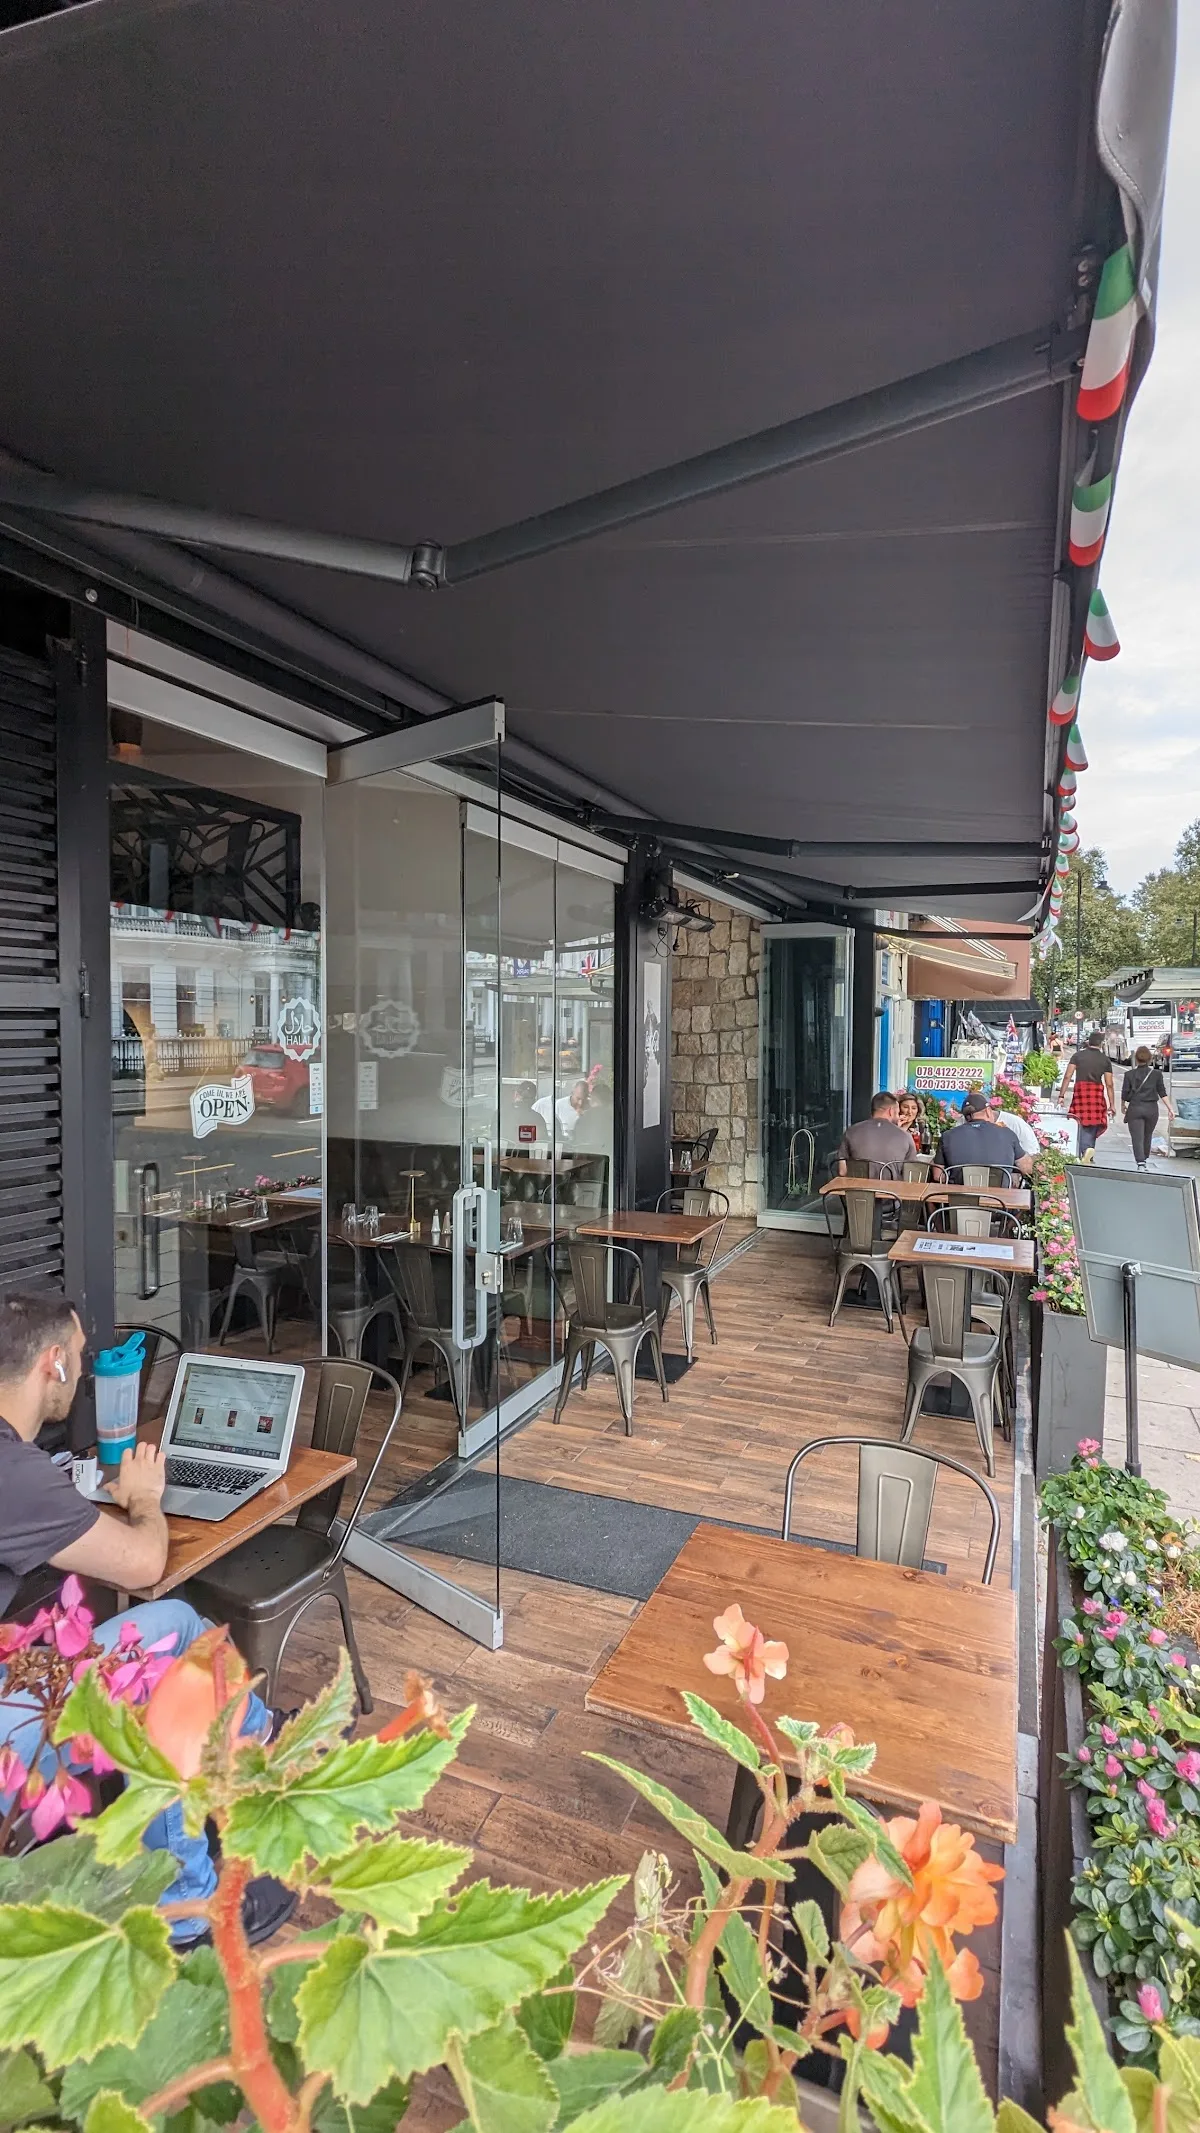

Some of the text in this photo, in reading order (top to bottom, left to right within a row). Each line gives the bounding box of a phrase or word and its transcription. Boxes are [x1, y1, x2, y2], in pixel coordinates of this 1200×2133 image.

[284, 1010, 314, 1035] حلال
[286, 1035, 312, 1046] HALAL
[916, 1066, 983, 1078] 078 4122 2222
[916, 1079, 934, 1089] 020
[935, 1079, 956, 1089] 7373
[199, 1090, 215, 1101] COME
[225, 1091, 233, 1099] WE
[235, 1088, 246, 1098] ARE
[200, 1095, 248, 1118] OPEN
